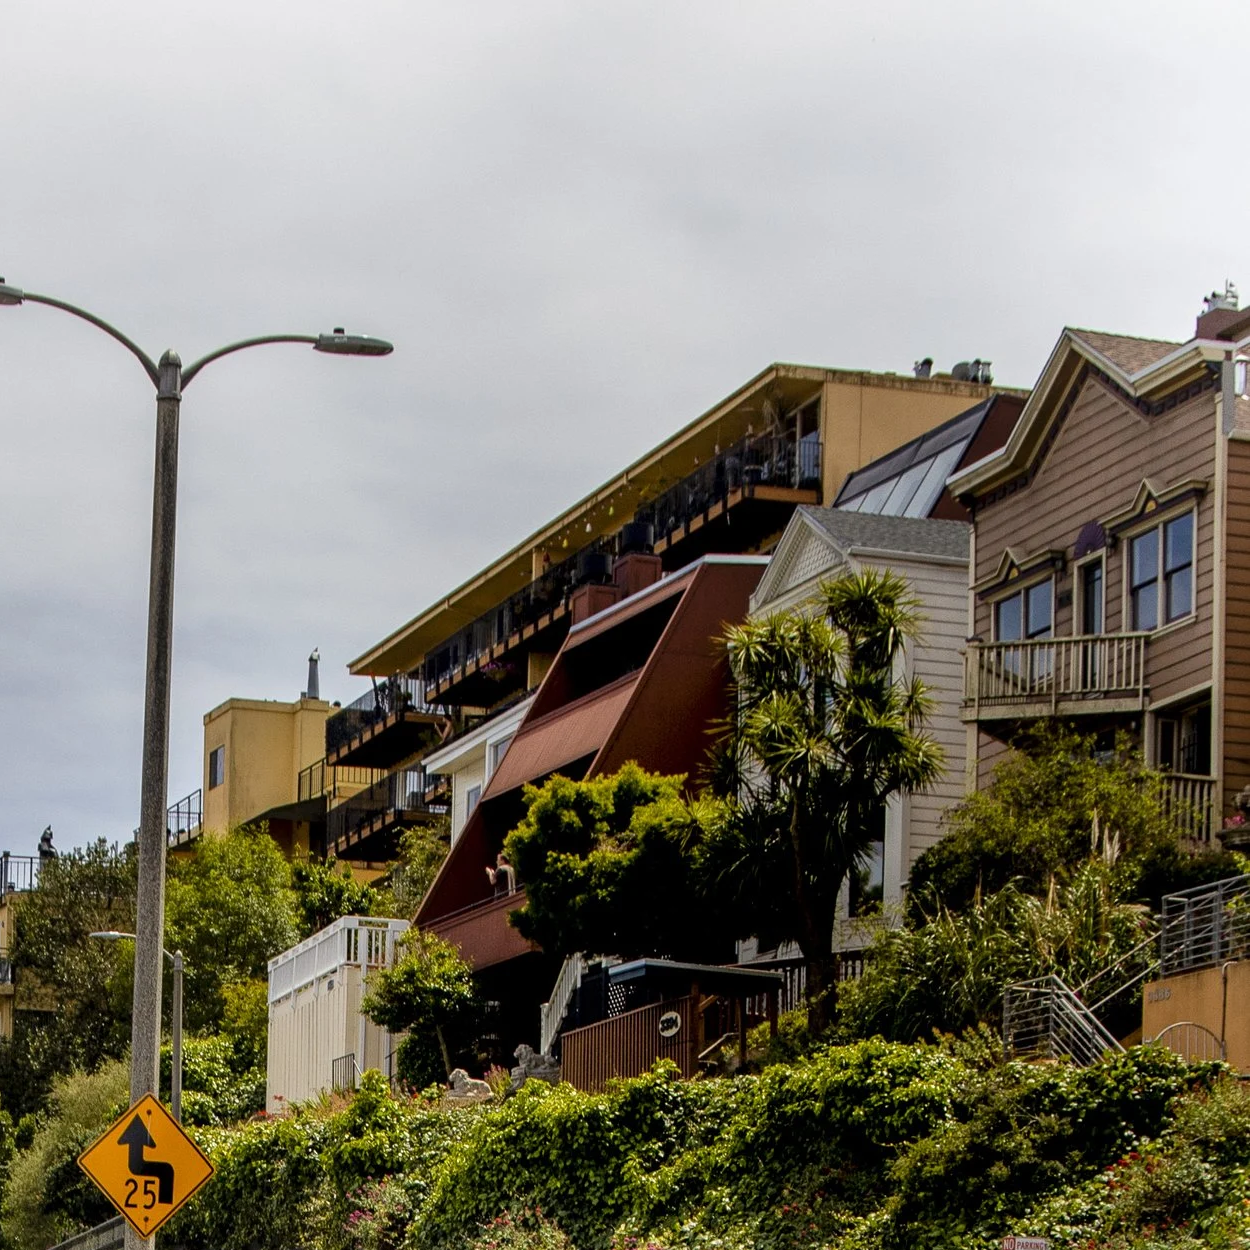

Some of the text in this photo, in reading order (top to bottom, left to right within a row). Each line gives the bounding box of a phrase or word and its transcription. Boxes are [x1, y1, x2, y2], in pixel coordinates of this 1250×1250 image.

[124, 1178, 157, 1210] 25
[1003, 1239, 1044, 1250] NO PARKING
